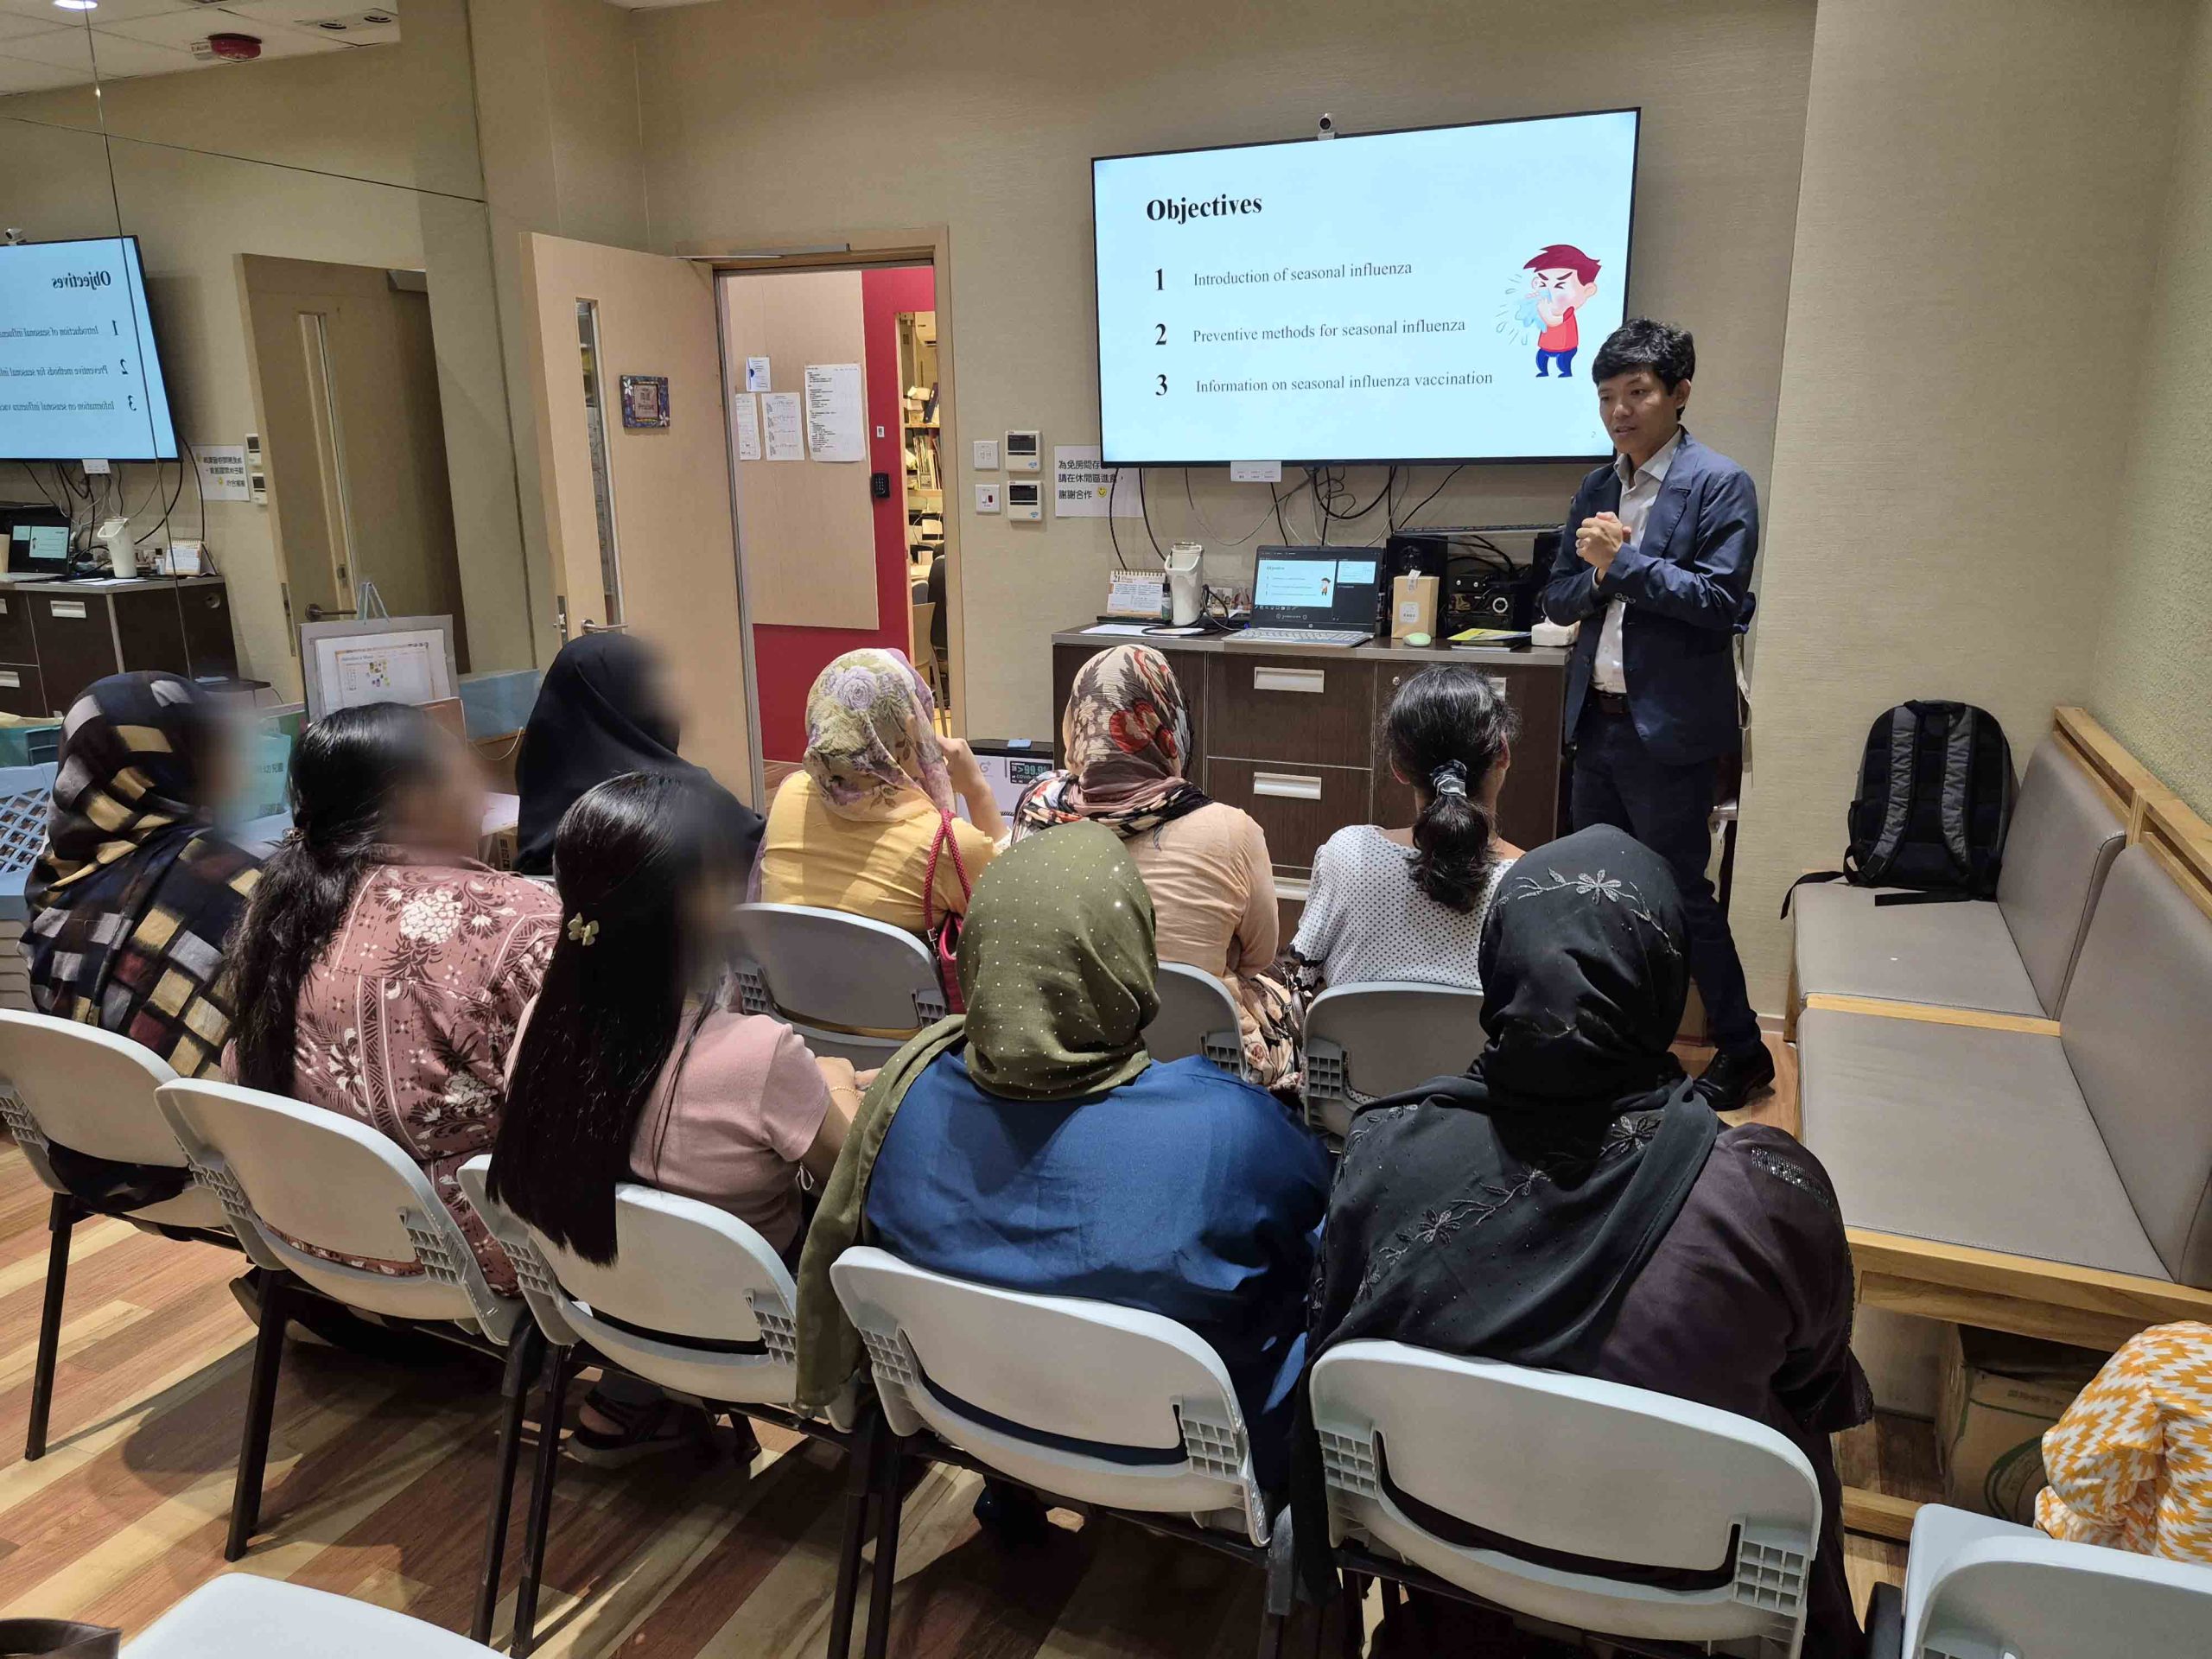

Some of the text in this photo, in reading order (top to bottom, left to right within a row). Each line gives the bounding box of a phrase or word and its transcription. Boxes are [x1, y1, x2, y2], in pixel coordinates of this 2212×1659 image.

[1146, 193, 1262, 225] Objectives
[1154, 262, 1413, 291] 1 Introduction of seasonal influenza
[1154, 318, 1465, 346] 2 Preventive methods for seasonal influenza
[1155, 370, 1493, 397] 3 Information on seasonal influenza vaccination
[1590, 430, 1597, 439] 2
[1058, 460, 1101, 470] 為免房間存
[1058, 489, 1093, 500] 謝謝合作
